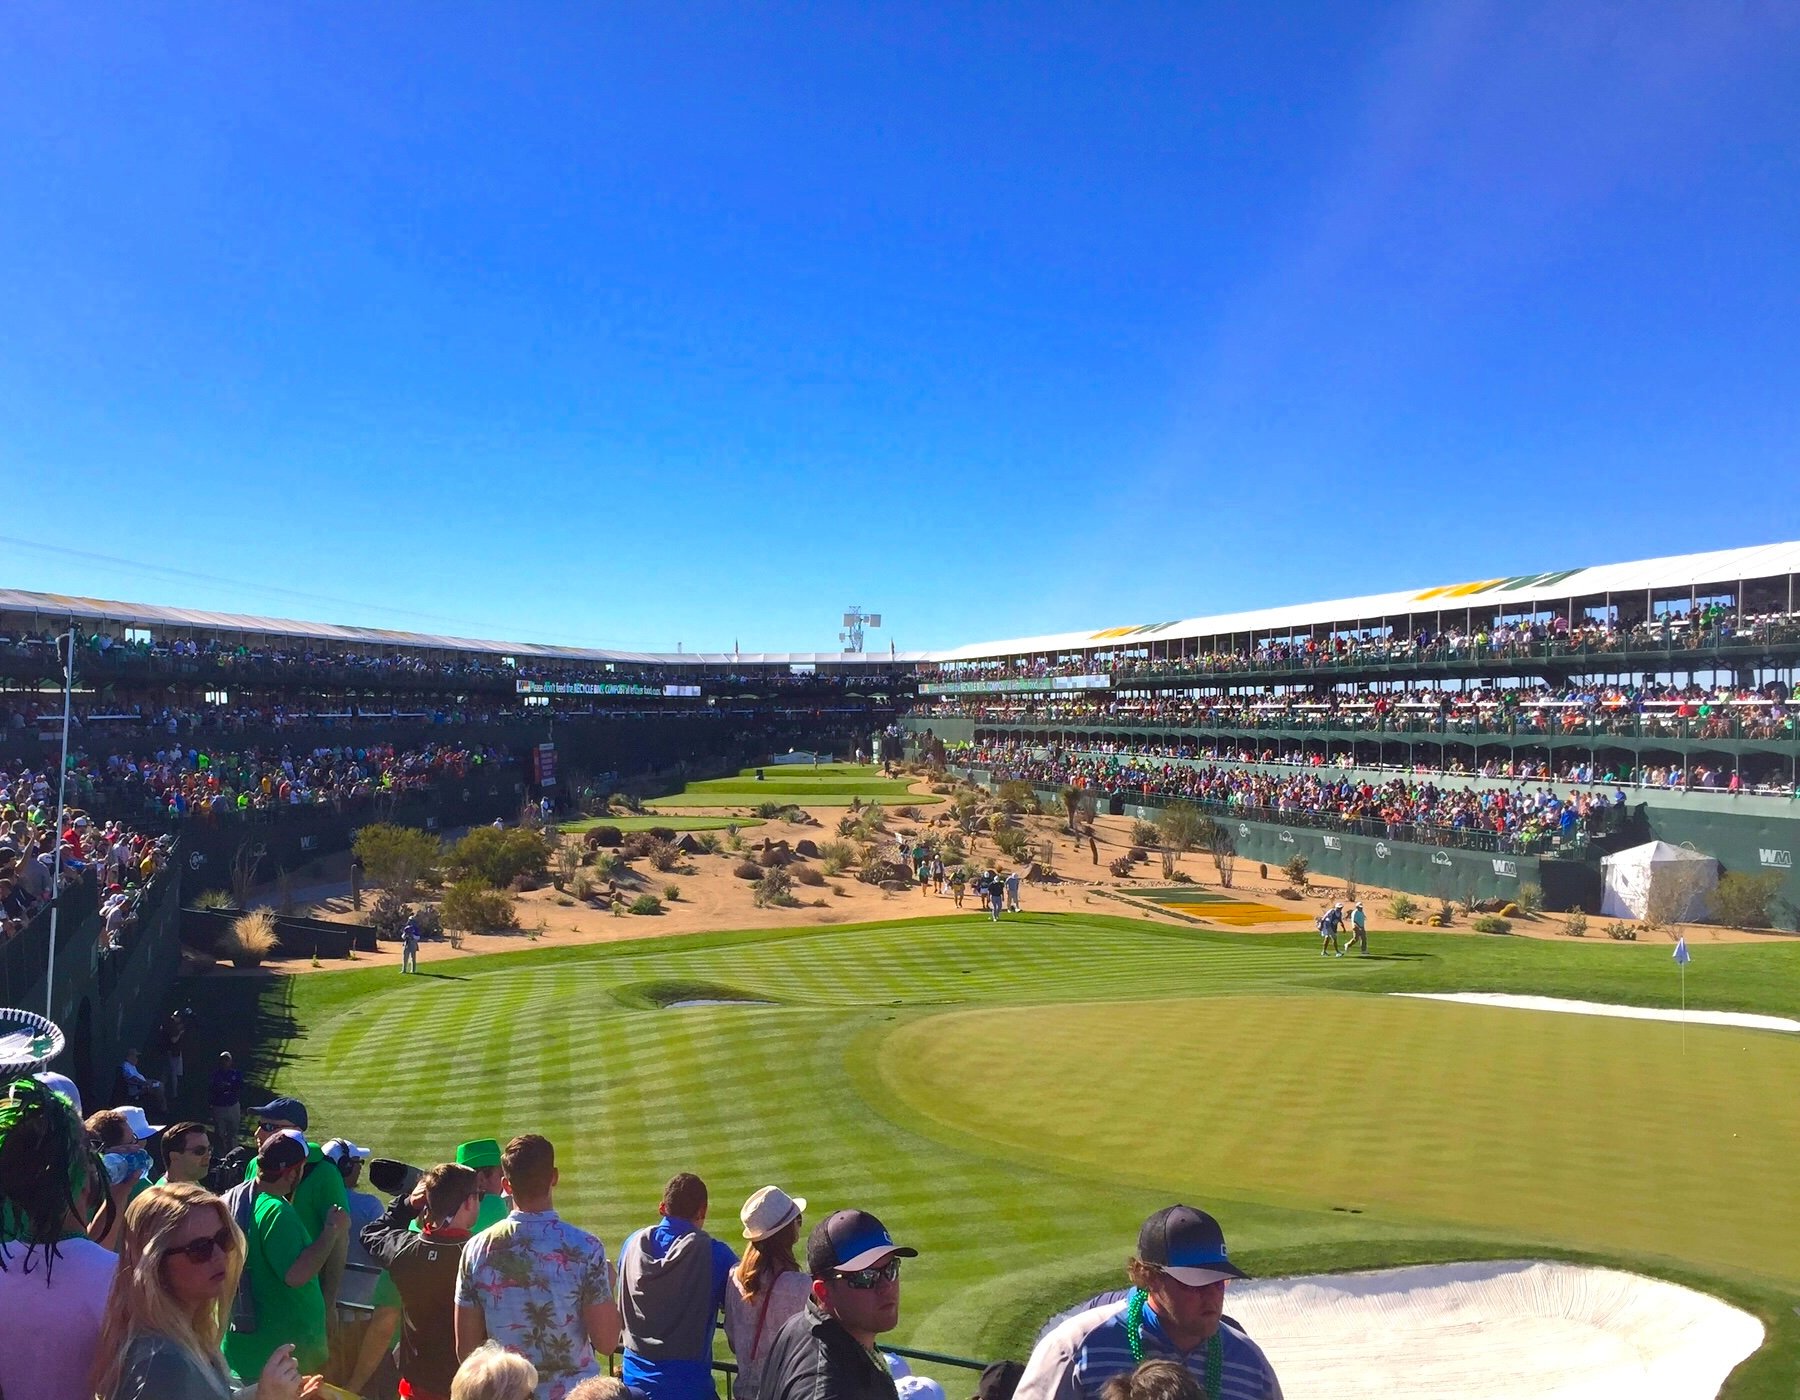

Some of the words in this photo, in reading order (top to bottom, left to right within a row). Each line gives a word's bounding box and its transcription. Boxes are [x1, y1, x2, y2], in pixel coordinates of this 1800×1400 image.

[1759, 848, 1793, 865] WM
[1492, 859, 1517, 875] WM
[428, 1250, 438, 1260] FJ
